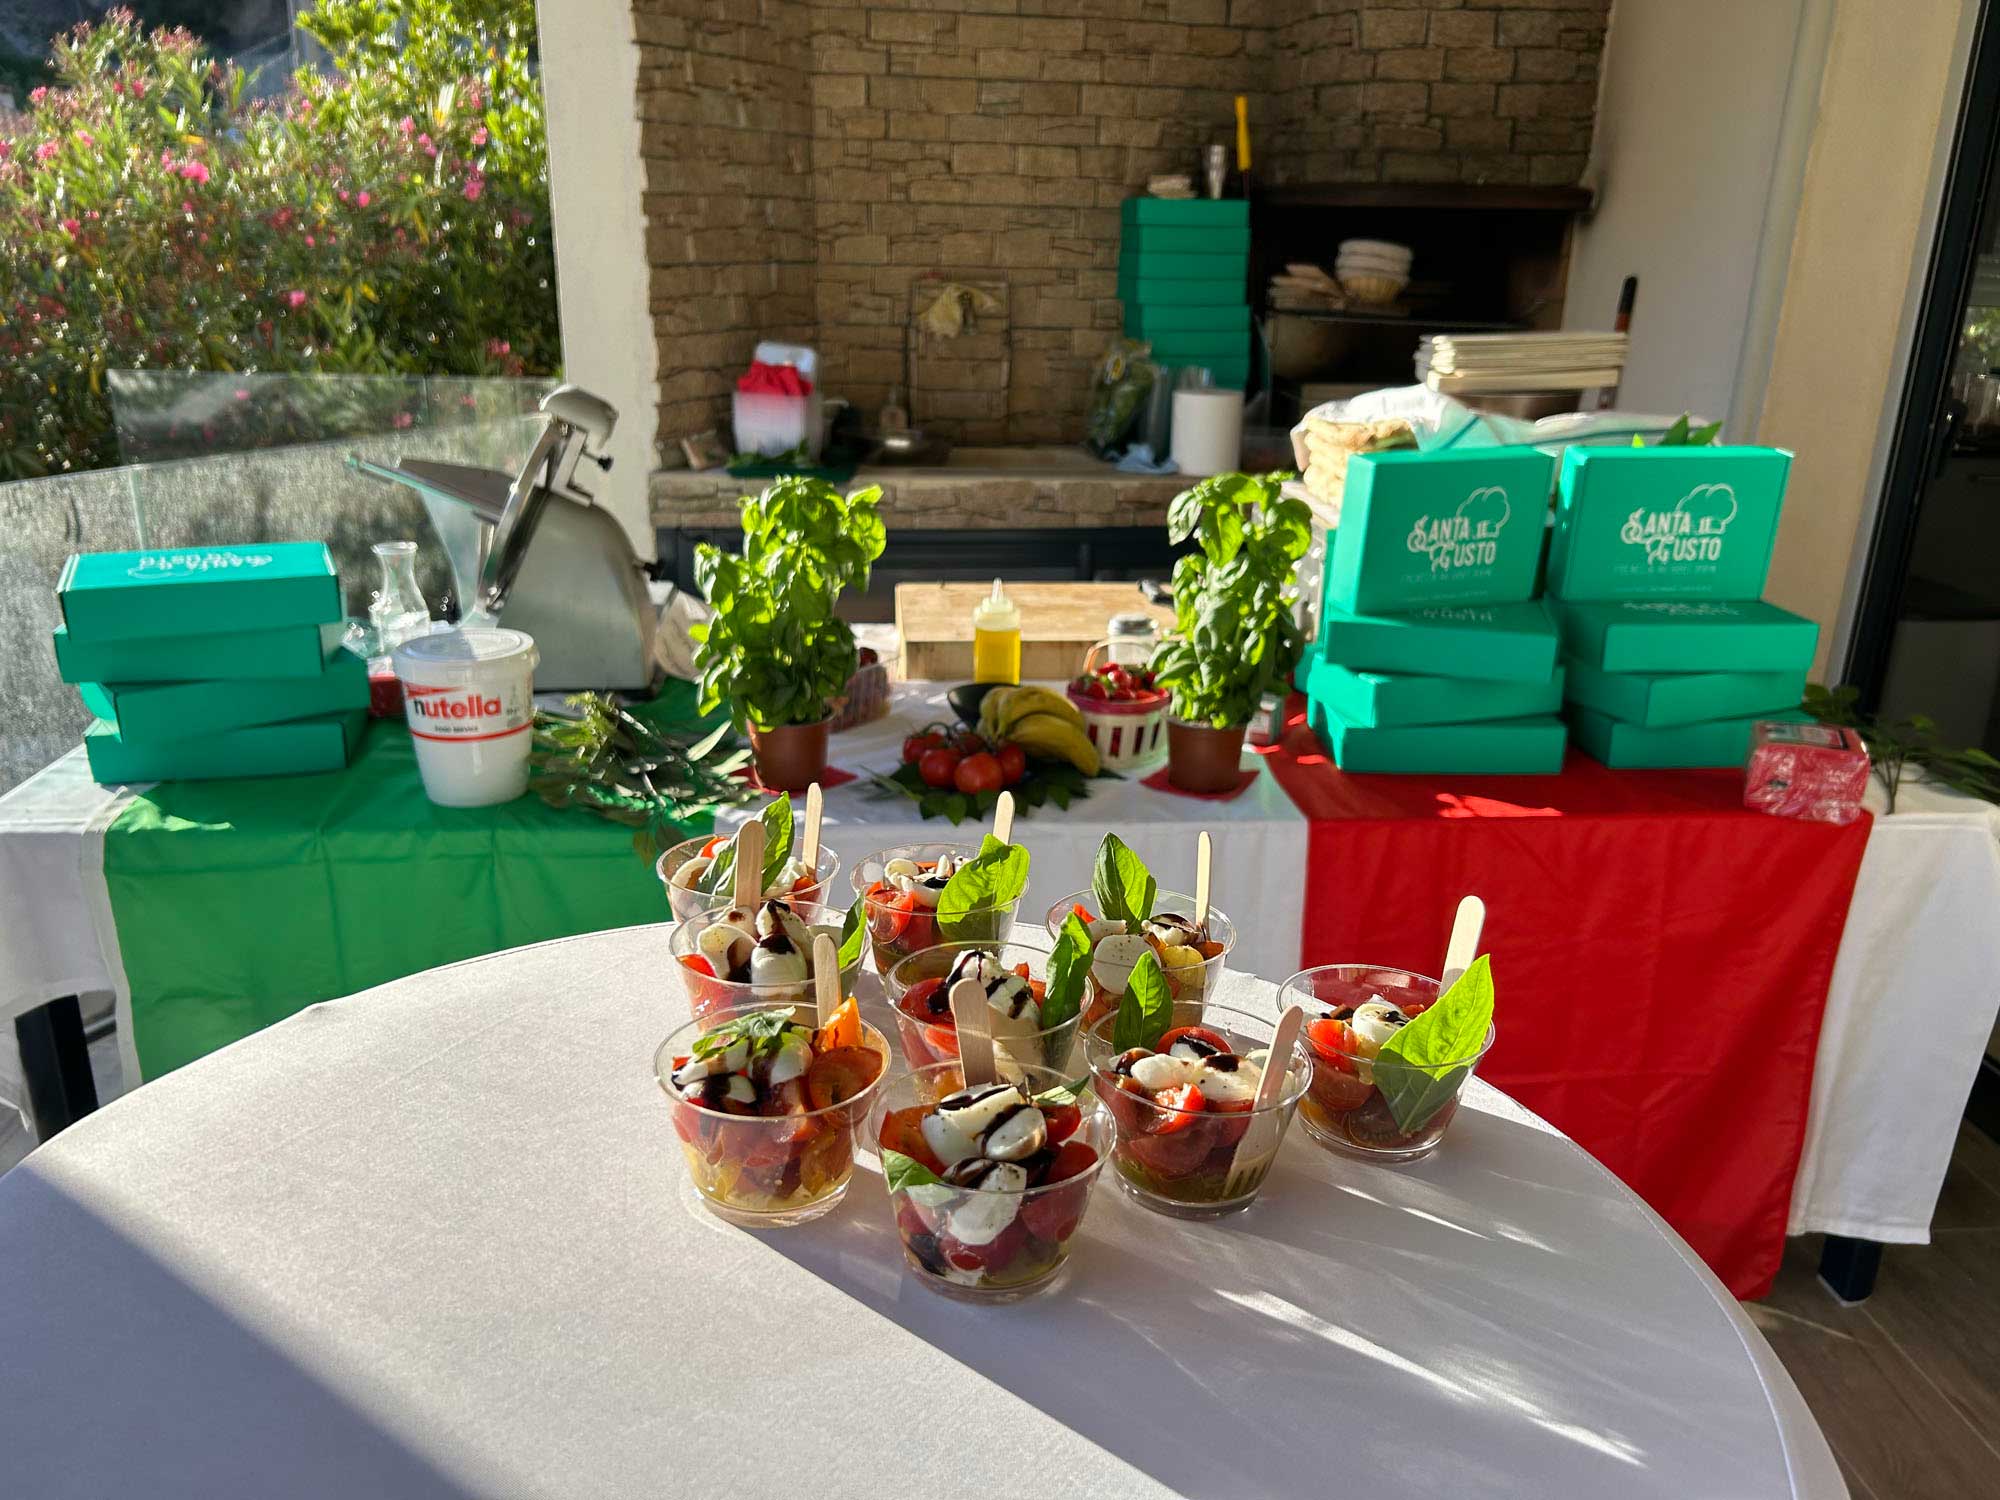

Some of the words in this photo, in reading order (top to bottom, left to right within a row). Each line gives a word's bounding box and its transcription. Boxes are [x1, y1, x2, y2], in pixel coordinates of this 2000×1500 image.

[1407, 514, 1470, 552] SANTA
[1621, 507, 1691, 544] SANTA
[1429, 541, 1497, 573] GUSTO
[1645, 535, 1722, 565] GUSTO
[413, 694, 502, 719] nutella
